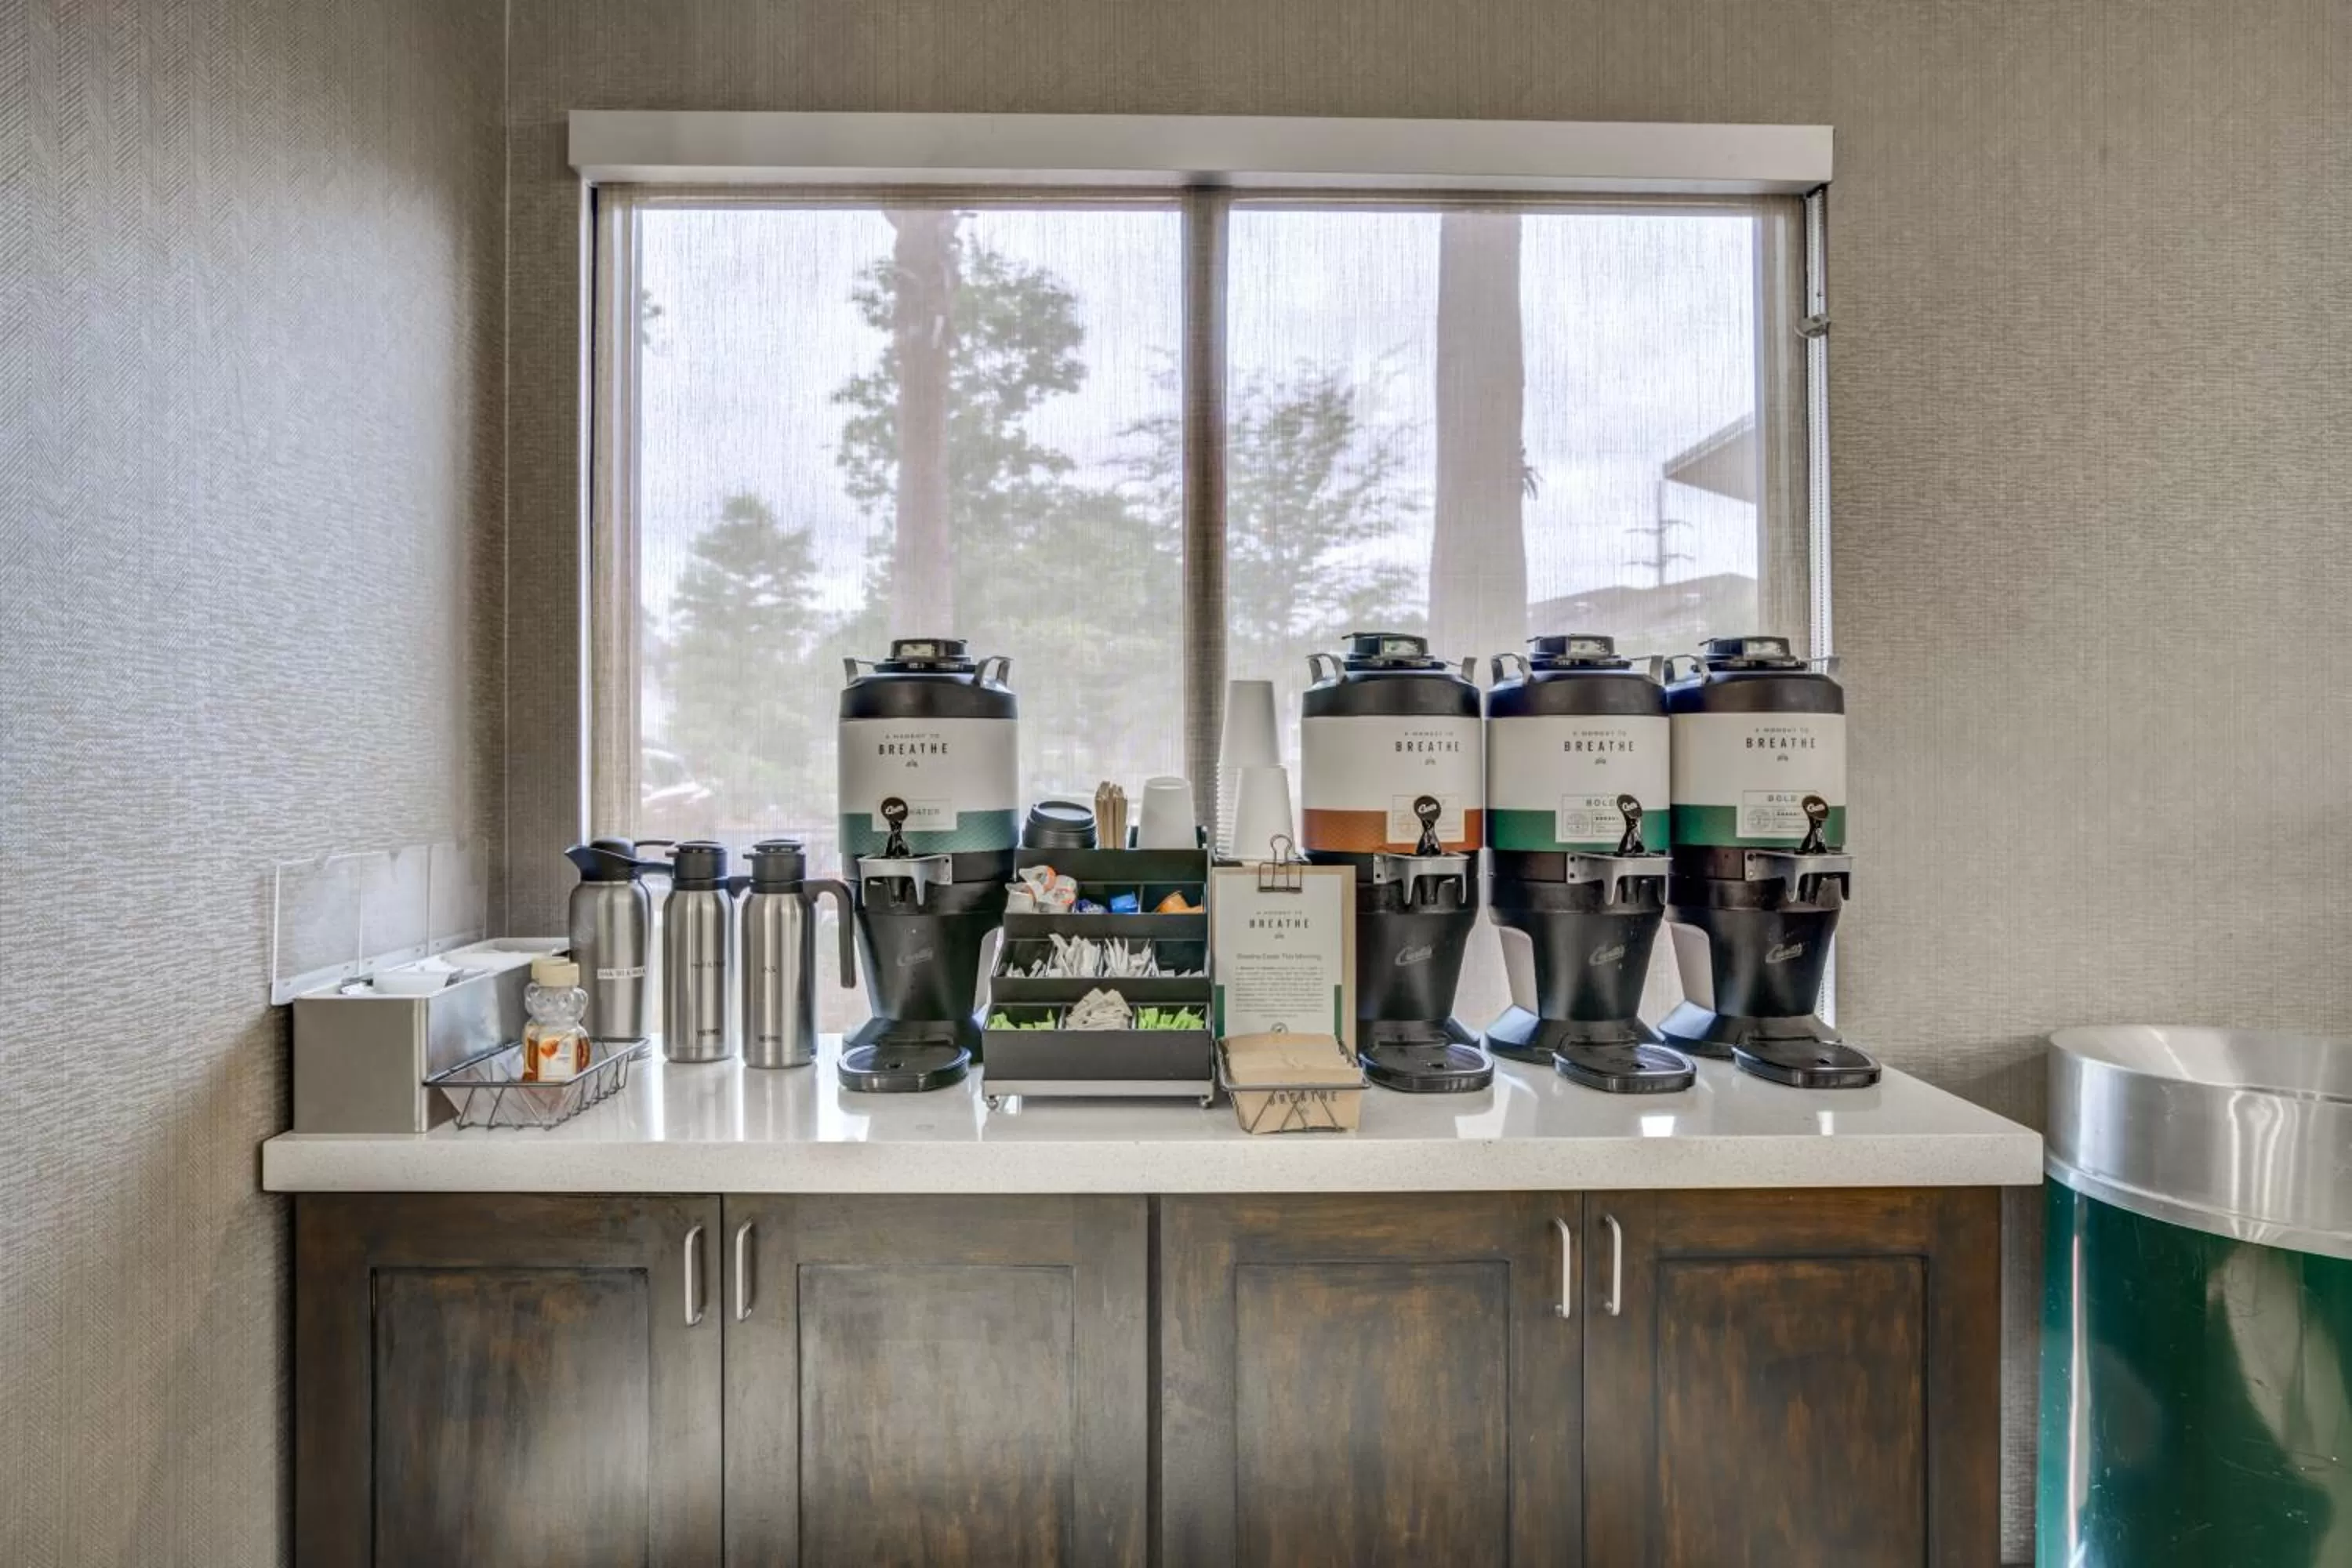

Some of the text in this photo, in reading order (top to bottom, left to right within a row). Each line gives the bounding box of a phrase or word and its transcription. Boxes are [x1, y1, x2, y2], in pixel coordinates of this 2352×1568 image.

[878, 742, 949, 755] BREATHE
[1395, 740, 1460, 753] BREATHE
[1563, 740, 1635, 753] BREATHE
[1745, 737, 1817, 750] BREATHE
[1249, 918, 1310, 930] BREATHE
[1269, 1091, 1338, 1105] BREATHE
